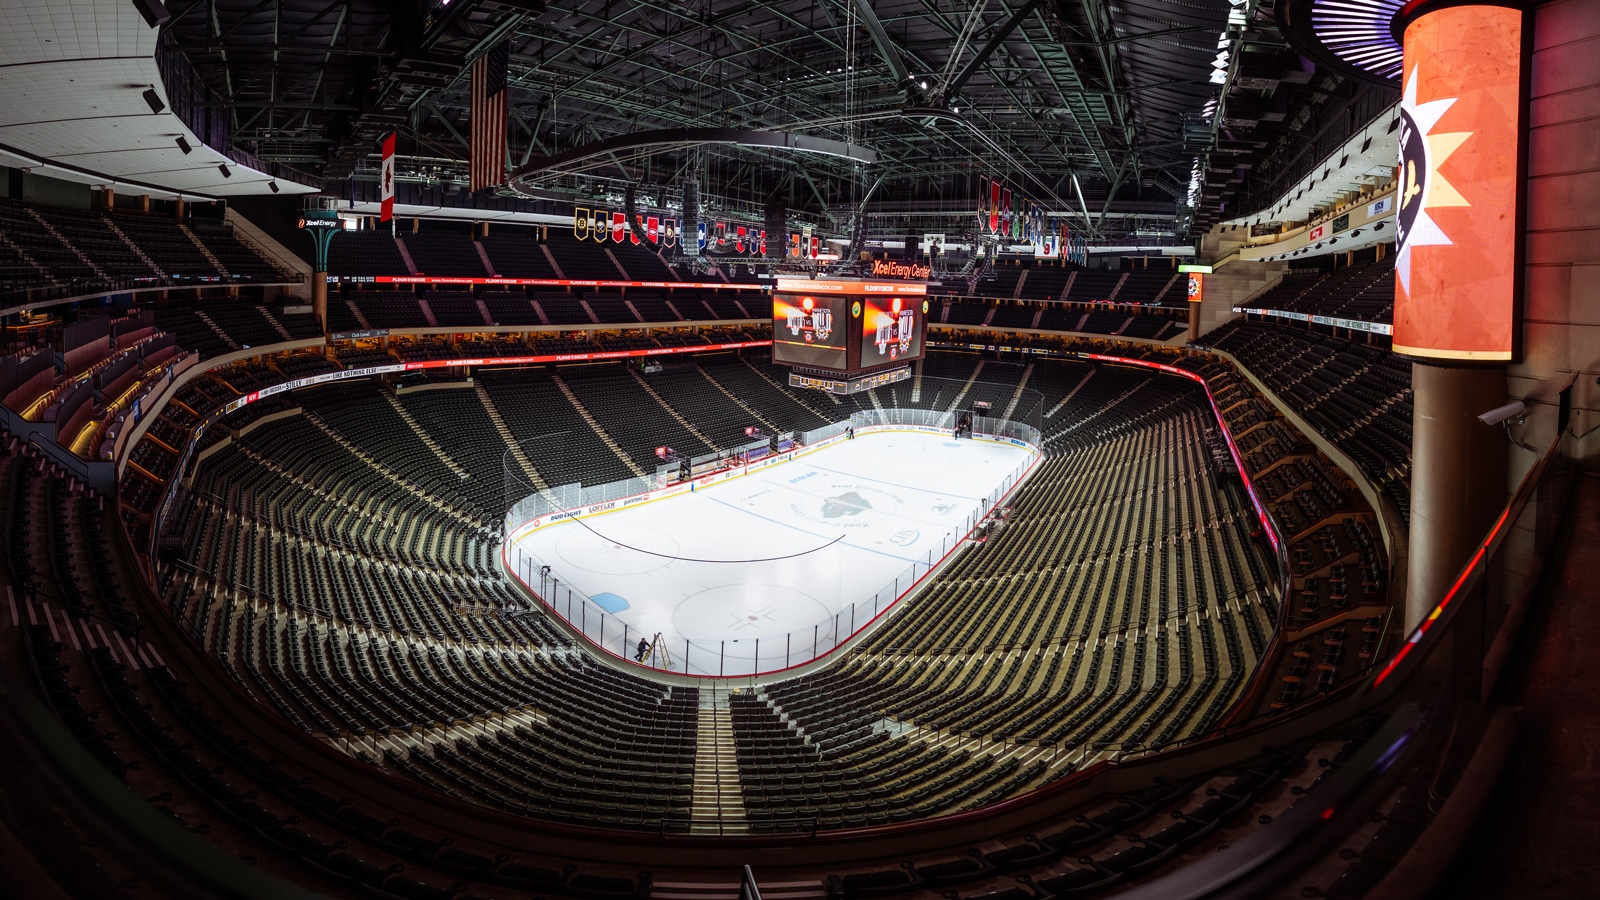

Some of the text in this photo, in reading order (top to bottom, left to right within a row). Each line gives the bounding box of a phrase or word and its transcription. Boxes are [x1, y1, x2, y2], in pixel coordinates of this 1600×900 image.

[319, 220, 336, 228] Energy
[872, 260, 930, 279] Xcel Energy Center
[344, 370, 365, 378] NOTHING
[588, 502, 615, 513] LOFFLER
